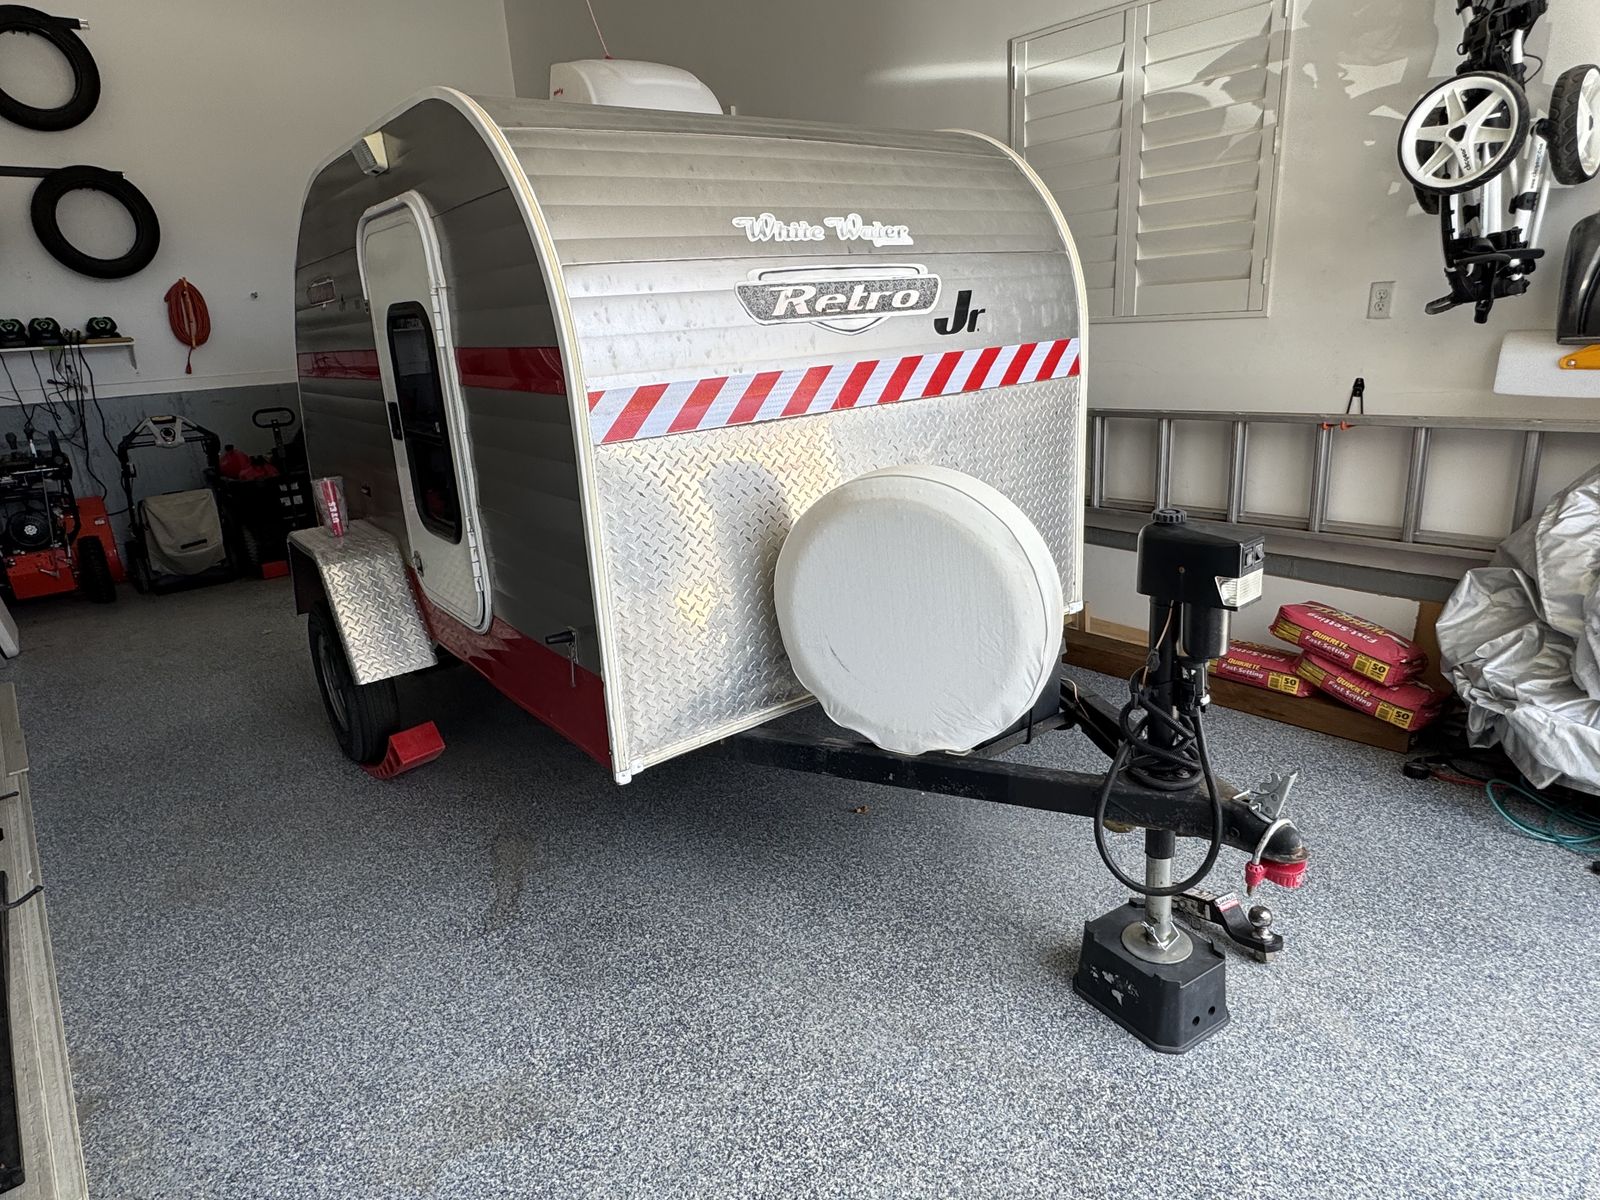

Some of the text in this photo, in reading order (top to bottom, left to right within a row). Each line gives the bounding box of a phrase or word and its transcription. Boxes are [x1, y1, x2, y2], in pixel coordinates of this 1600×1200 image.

[732, 213, 913, 247] White Water
[770, 284, 920, 316] Retro
[1304, 635, 1350, 659] Fast-Setting
[1312, 630, 1350, 650] QUIKRETE
[1221, 663, 1264, 679] Fast-Setting
[1227, 657, 1261, 670] QUIKRETE
[1370, 663, 1386, 673] 50
[1283, 677, 1297, 686] 50
[1335, 676, 1371, 698] QUIKRETE
[1328, 680, 1373, 707] Fast-Setting
[1395, 711, 1410, 720] 50
